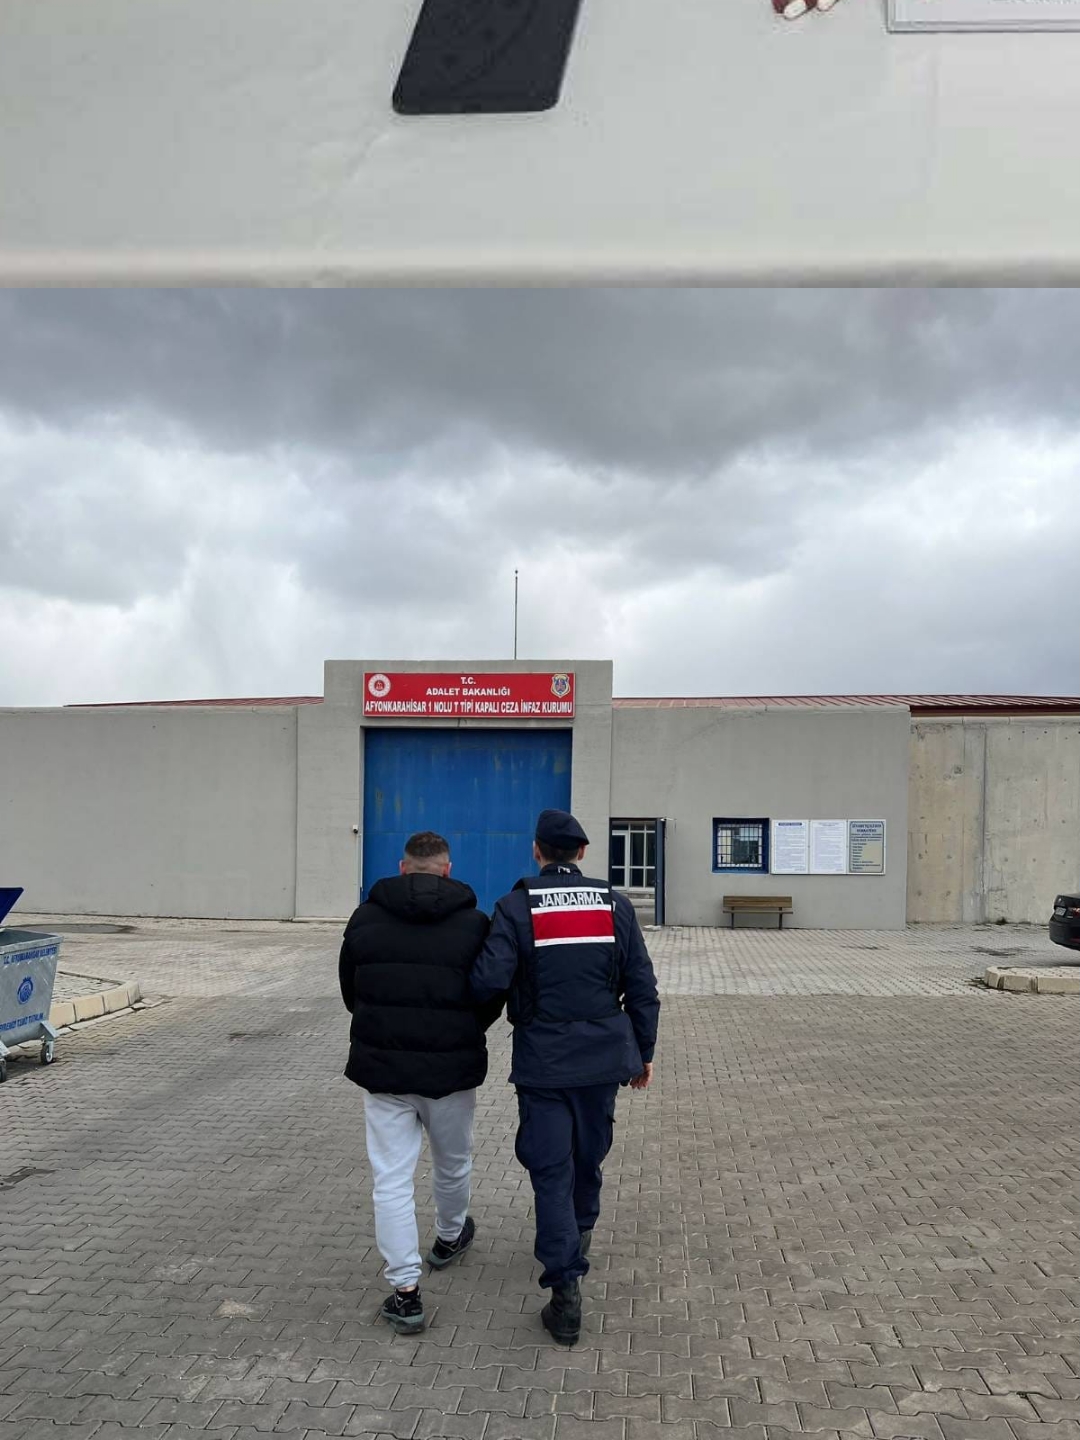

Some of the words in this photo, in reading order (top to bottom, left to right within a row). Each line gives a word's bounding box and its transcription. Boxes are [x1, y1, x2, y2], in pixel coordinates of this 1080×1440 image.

[460, 676, 476, 685] T.C.
[426, 687, 460, 696] ADALET
[462, 686, 511, 696] BAKANLIĞI
[365, 698, 427, 713] AFYONKARAHİSAR
[428, 701, 432, 713] 1
[434, 701, 453, 713] NOLU
[454, 701, 459, 713] T
[460, 699, 474, 713] TİPİ
[475, 701, 500, 713] KAPALI
[500, 701, 520, 713] CEZA
[521, 698, 541, 713] İNFAZ
[541, 701, 573, 713] KURUMU
[538, 891, 604, 907] JANDARMA
